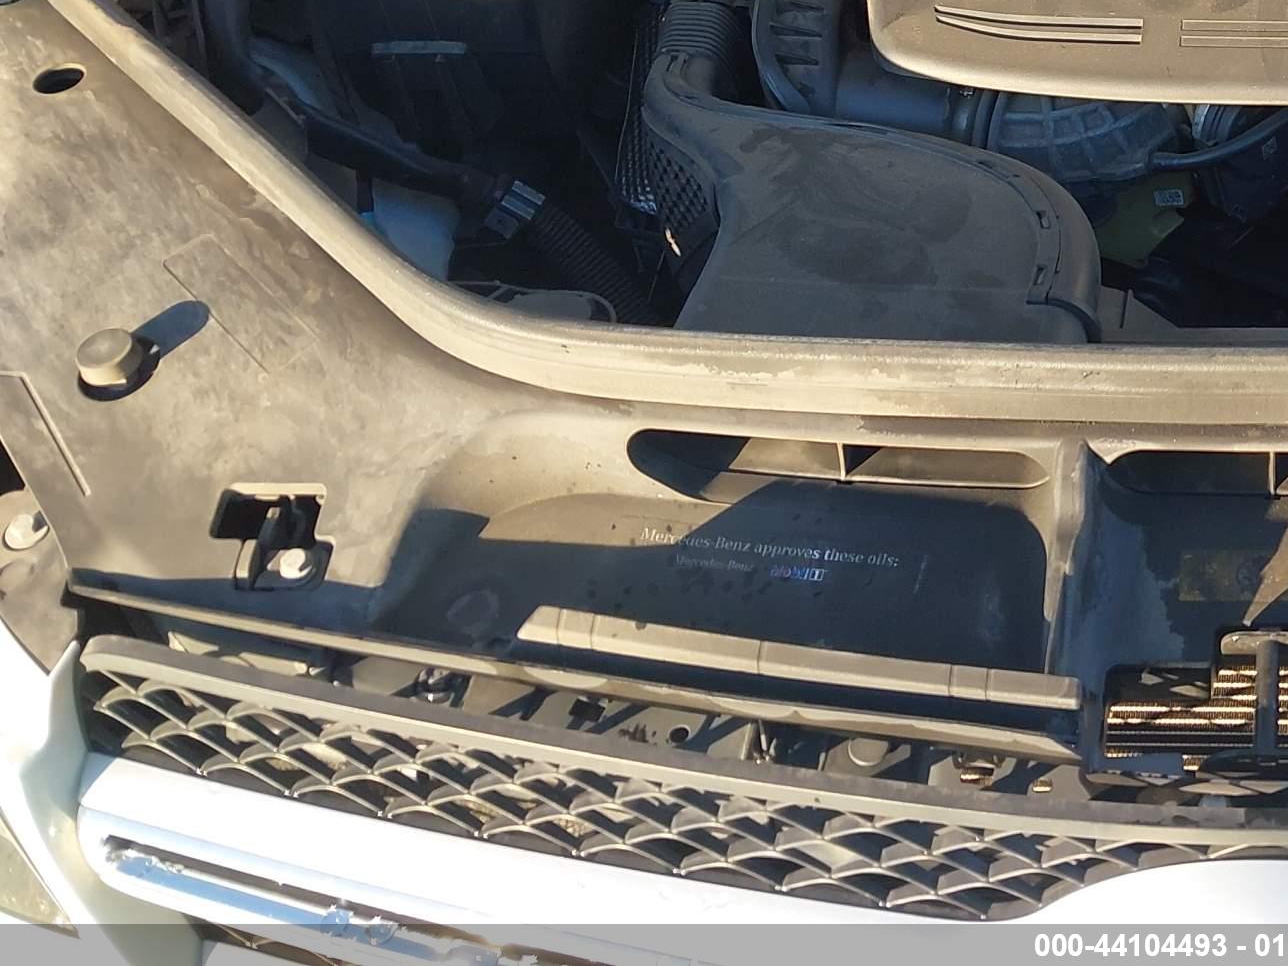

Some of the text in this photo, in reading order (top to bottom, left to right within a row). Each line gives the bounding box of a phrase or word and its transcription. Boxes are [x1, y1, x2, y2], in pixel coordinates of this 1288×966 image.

[639, 527, 900, 567] Mercedes-Benz approves these oils:
